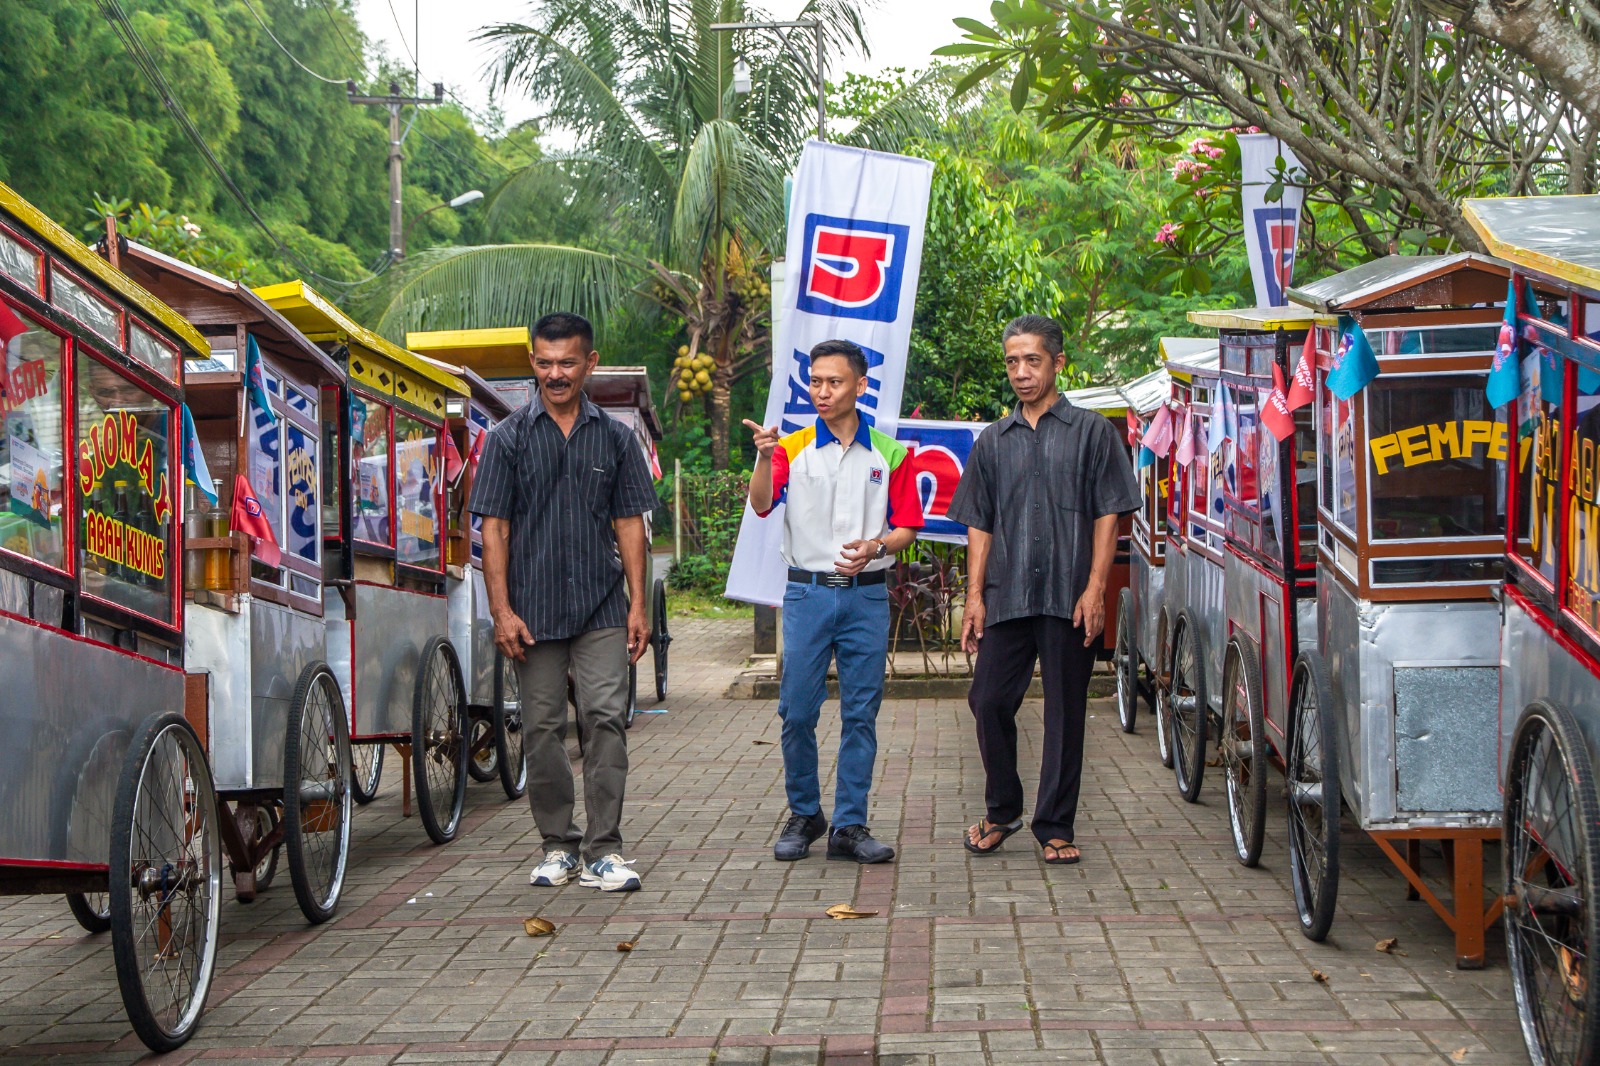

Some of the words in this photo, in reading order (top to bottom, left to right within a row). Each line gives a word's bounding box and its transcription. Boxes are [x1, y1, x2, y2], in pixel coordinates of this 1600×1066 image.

[79, 408, 172, 525] SIOMAY
[86, 508, 124, 565] ABAH
[125, 524, 165, 580] KUMIS
